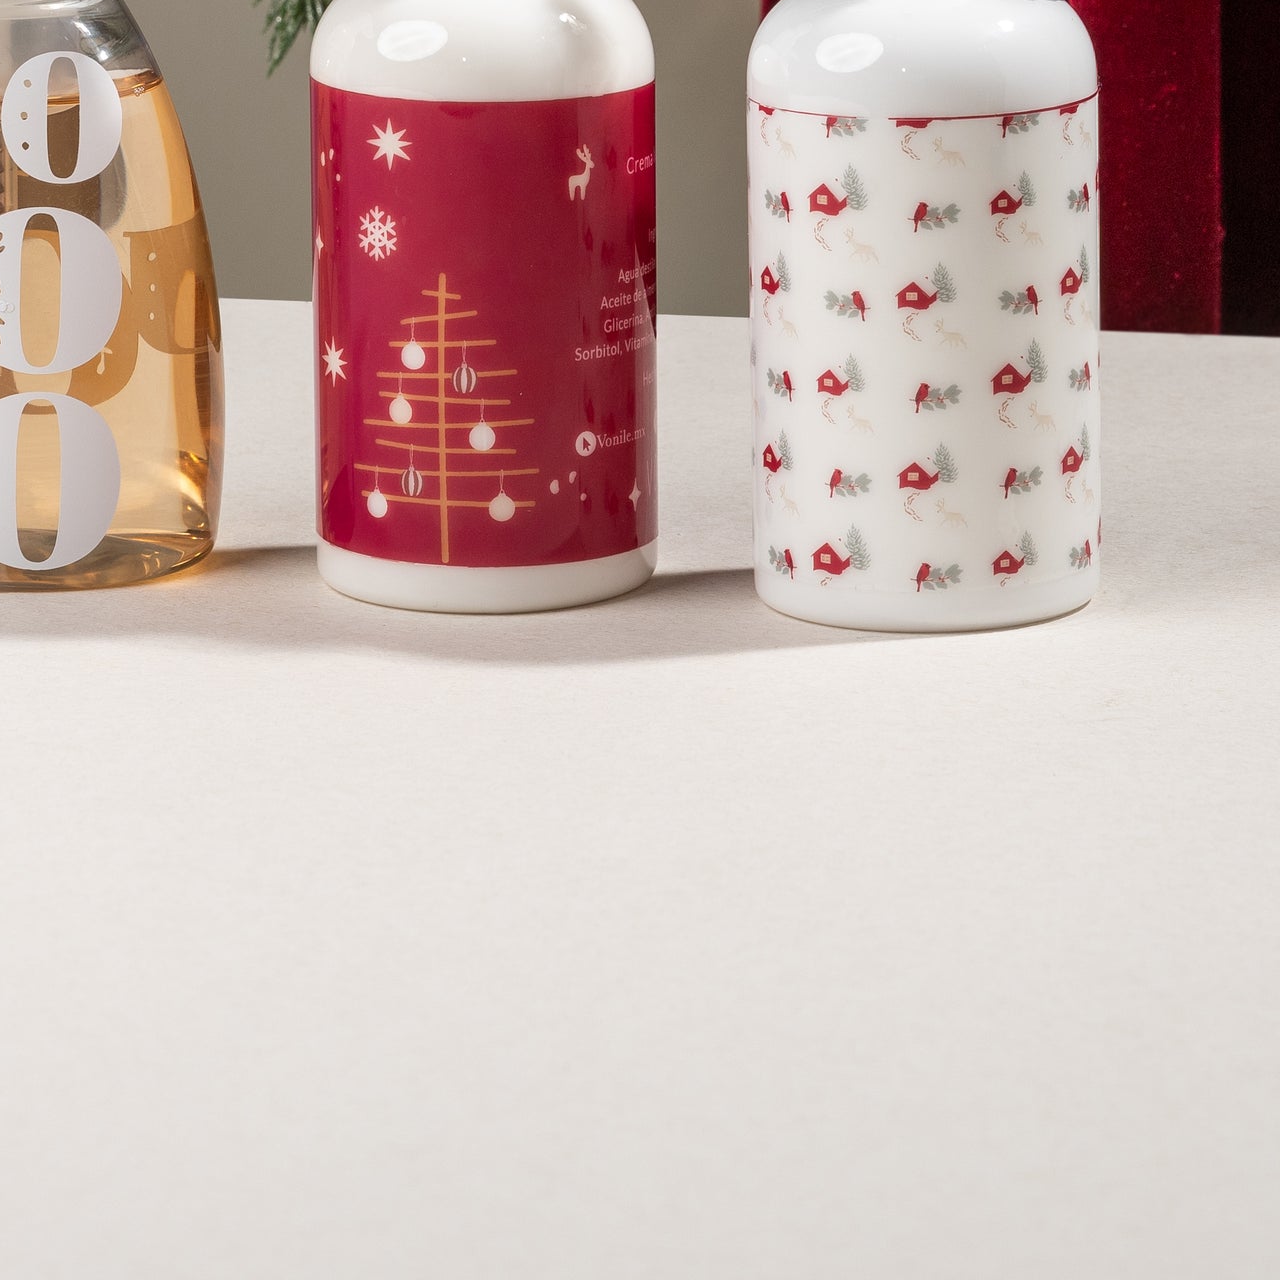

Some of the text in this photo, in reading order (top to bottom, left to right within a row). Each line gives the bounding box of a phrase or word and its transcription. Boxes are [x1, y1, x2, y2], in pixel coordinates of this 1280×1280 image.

[618, 267, 639, 283] Agua
[600, 293, 632, 310] Aceite
[574, 340, 623, 362] Sorbitol,
